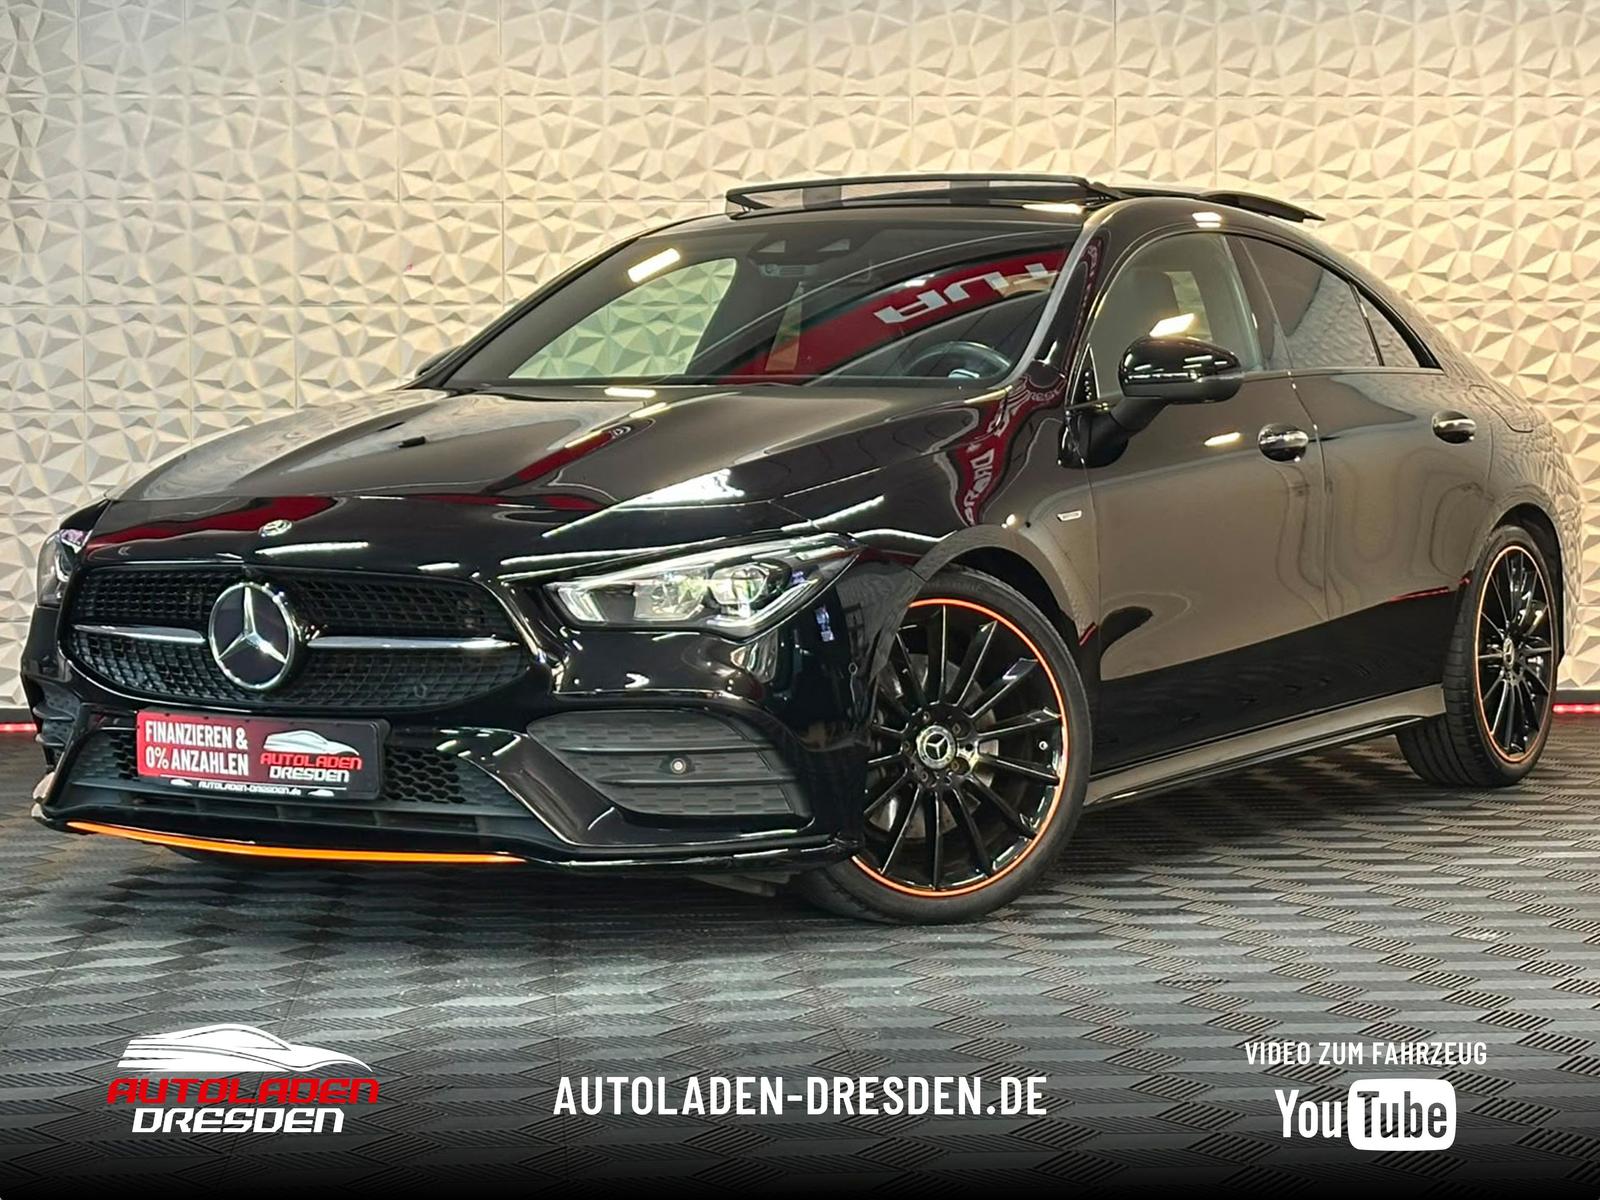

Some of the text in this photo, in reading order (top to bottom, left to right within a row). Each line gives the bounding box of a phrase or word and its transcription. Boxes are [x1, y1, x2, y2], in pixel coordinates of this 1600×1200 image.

[145, 720, 248, 750] FINANZIEREN &
[145, 746, 249, 777] 0% ANZAHLEN
[260, 753, 362, 771] AUTOLADEN
[269, 765, 350, 783] DRESDEN
